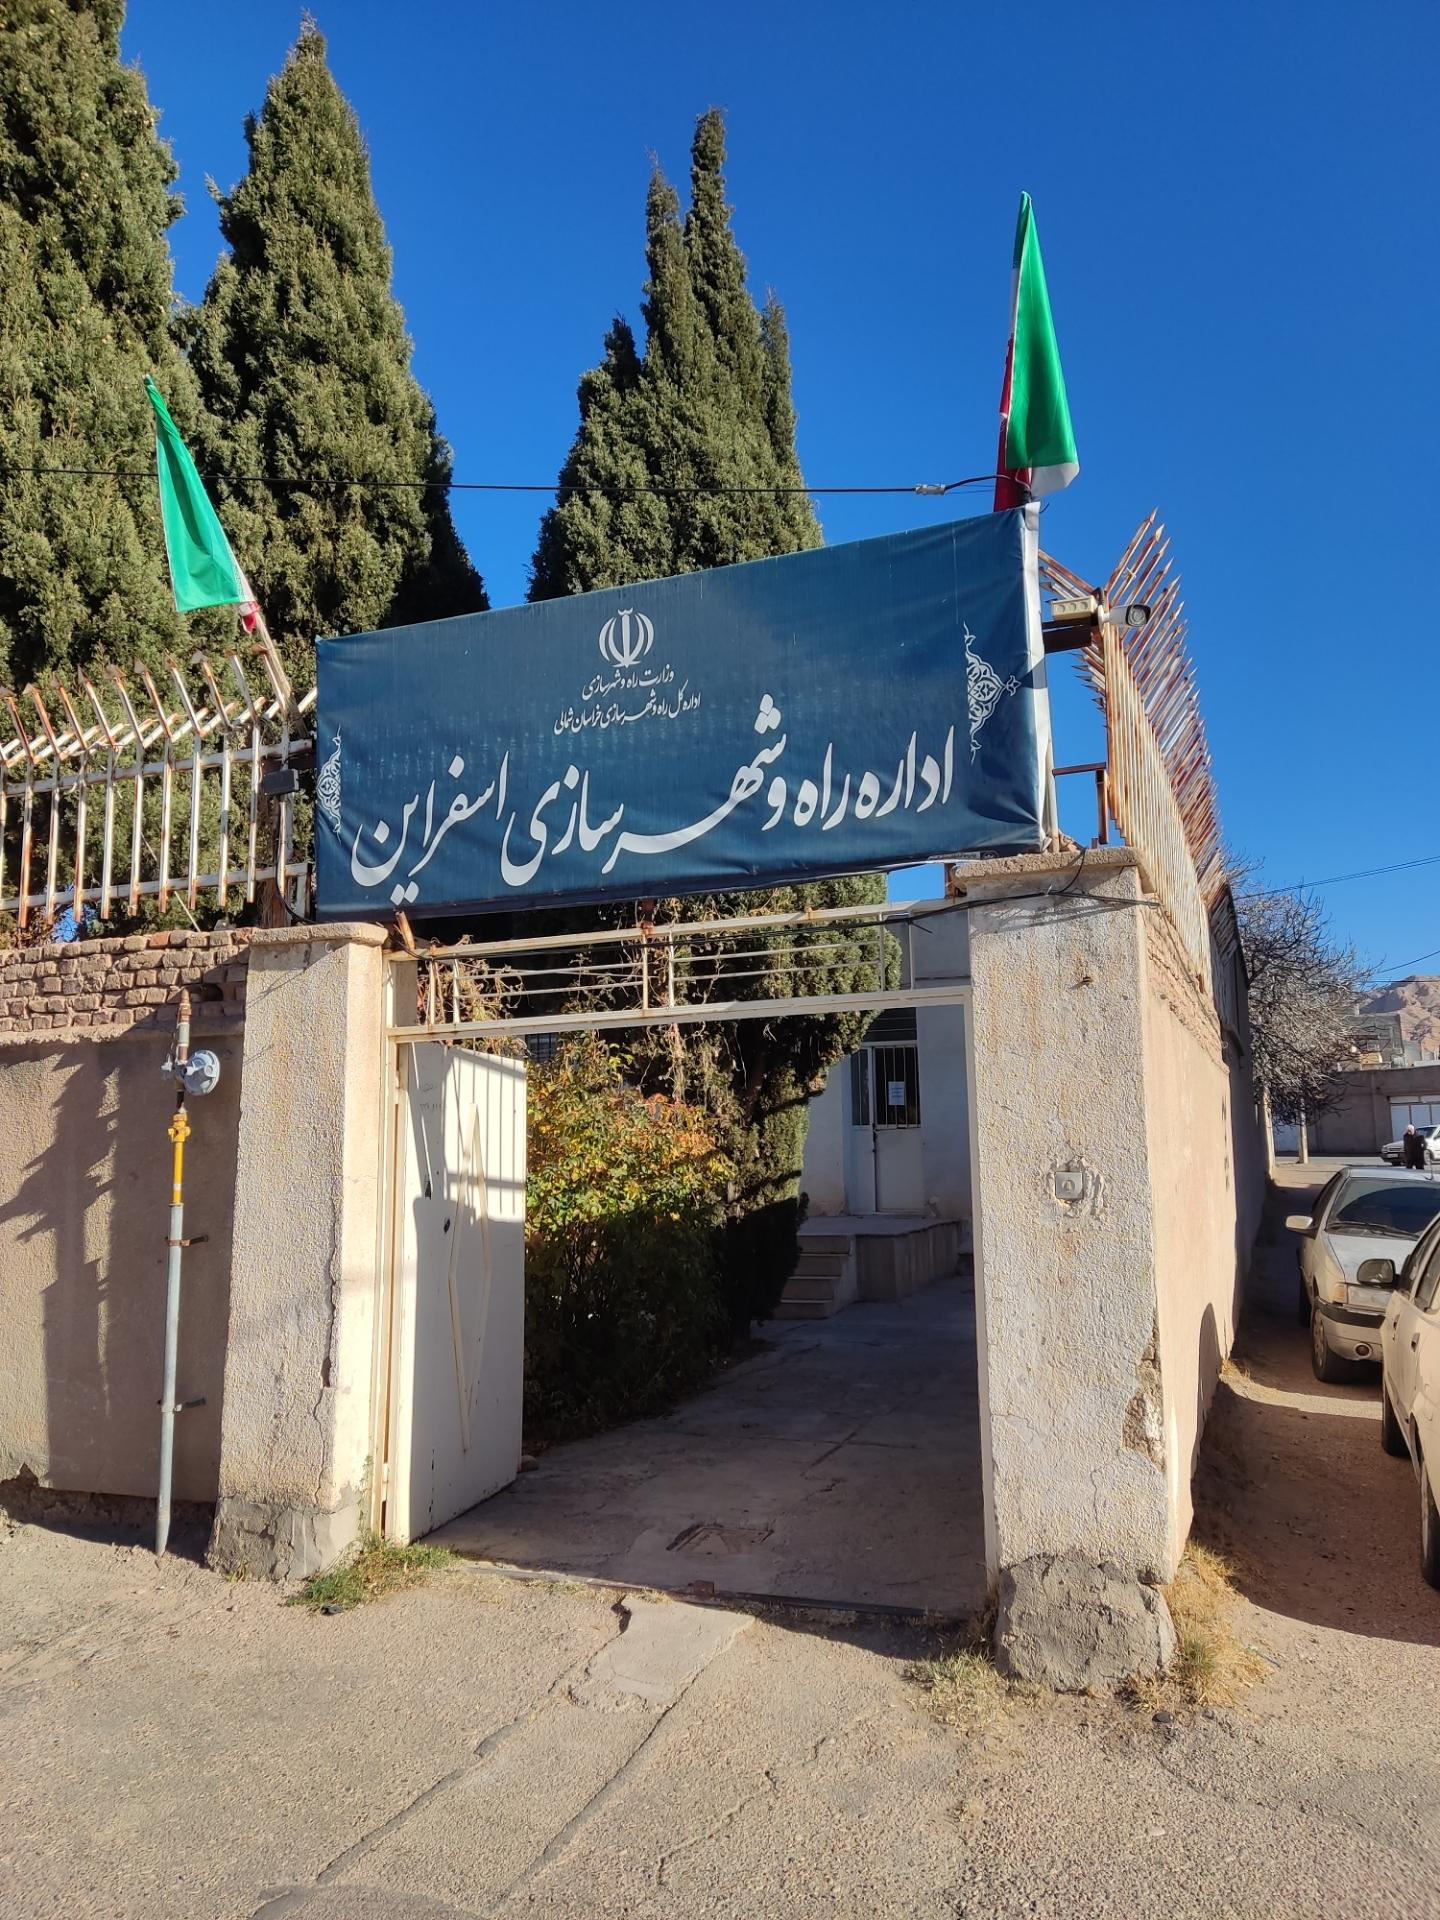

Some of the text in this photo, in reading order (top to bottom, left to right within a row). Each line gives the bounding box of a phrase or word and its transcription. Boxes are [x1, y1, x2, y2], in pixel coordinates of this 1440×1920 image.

[581, 668, 622, 701] شهرسازی
[626, 673, 640, 689] راه
[638, 663, 675, 687] وزارت
[657, 698, 669, 716] راه
[668, 679, 689, 719] کل
[682, 692, 701, 711] اداره
[553, 707, 574, 736] شمالی
[571, 703, 603, 734] خراسان
[793, 742, 851, 831] راه
[854, 725, 954, 819] اداره
[351, 751, 510, 906] اسفراین
